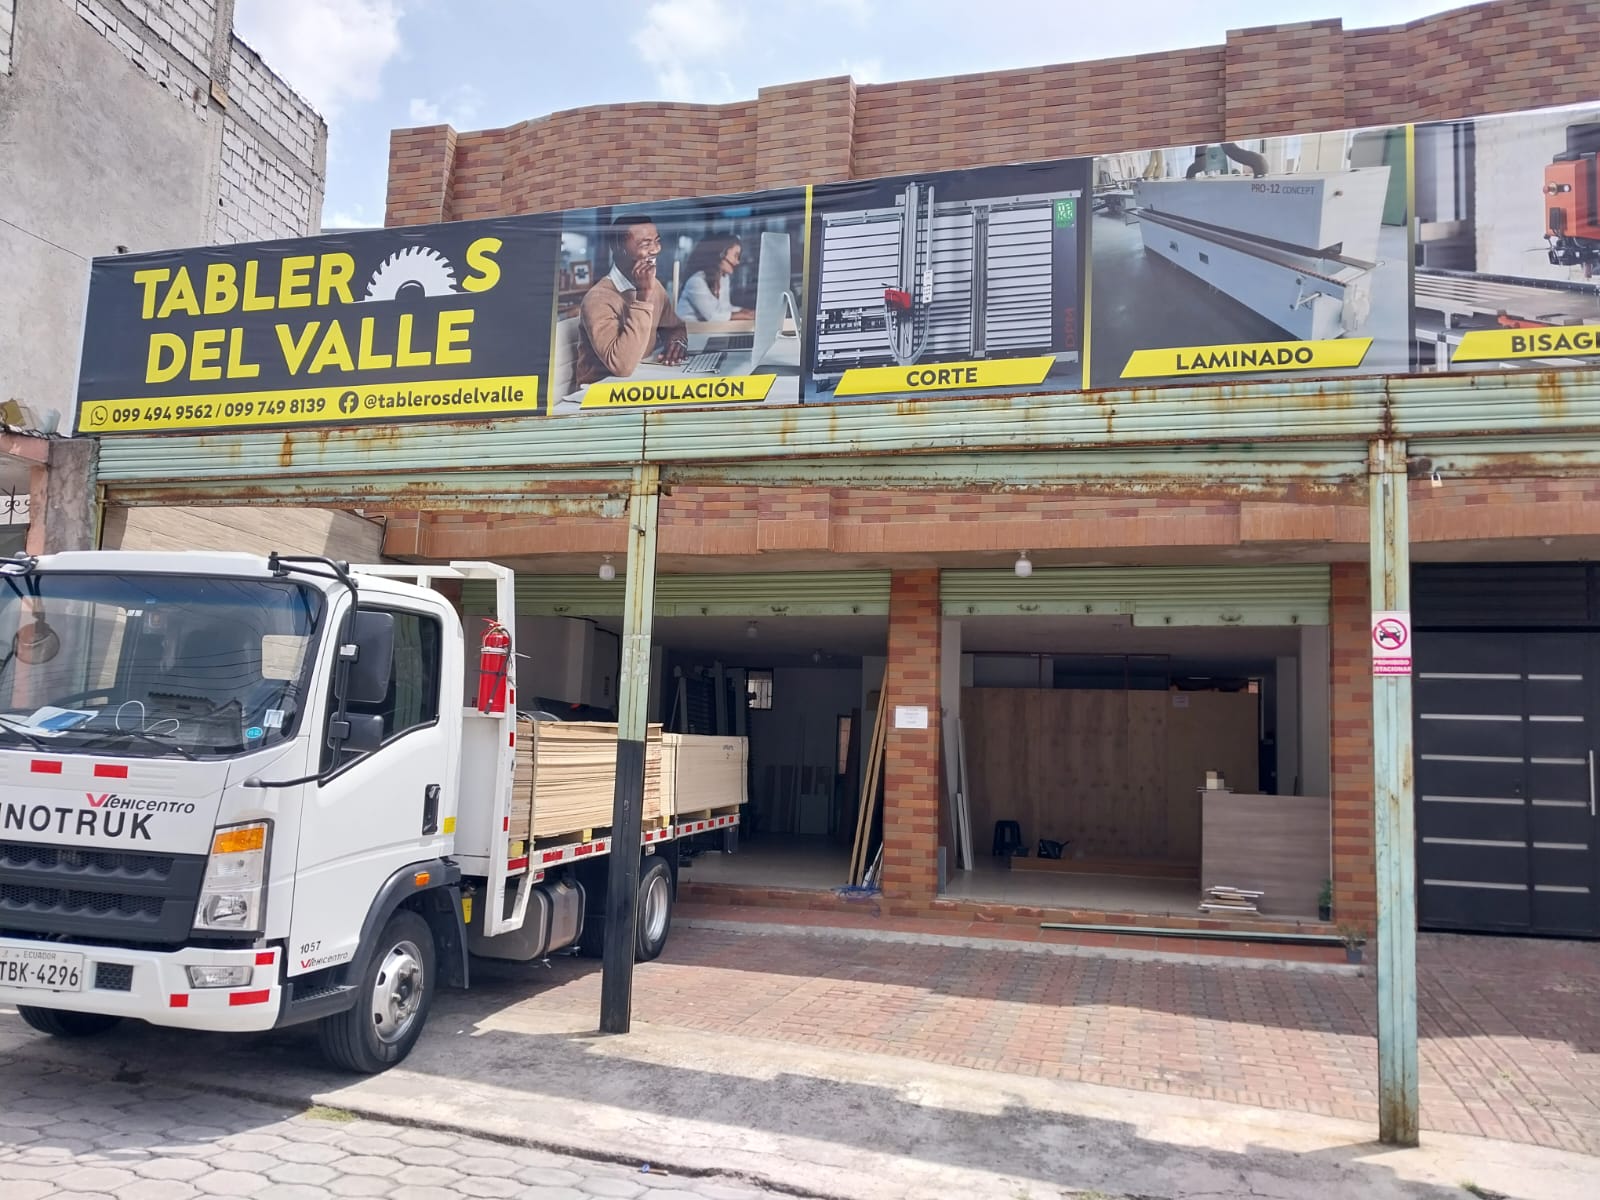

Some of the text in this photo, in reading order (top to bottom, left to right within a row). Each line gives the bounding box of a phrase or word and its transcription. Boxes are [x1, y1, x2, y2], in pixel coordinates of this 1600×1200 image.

[1251, 183, 1280, 194] PRO-12
[145, 309, 475, 384] DEL VALLE
[1176, 347, 1314, 370] LAMINADO
[906, 367, 978, 387] CORTE
[364, 386, 524, 409] @tablerosdelvalle
[609, 378, 744, 403] MODULACIÓN
[112, 408, 141, 423] 099
[144, 407, 171, 421] 494
[176, 404, 213, 420] 9562
[224, 402, 254, 417] 099
[257, 400, 286, 416] 749
[290, 398, 326, 414] 8139
[0, 802, 154, 840] NOTRUK
[23, 951, 57, 960] ECUADOR
[300, 940, 321, 954] 1057
[0, 961, 79, 986] TBK-4296
